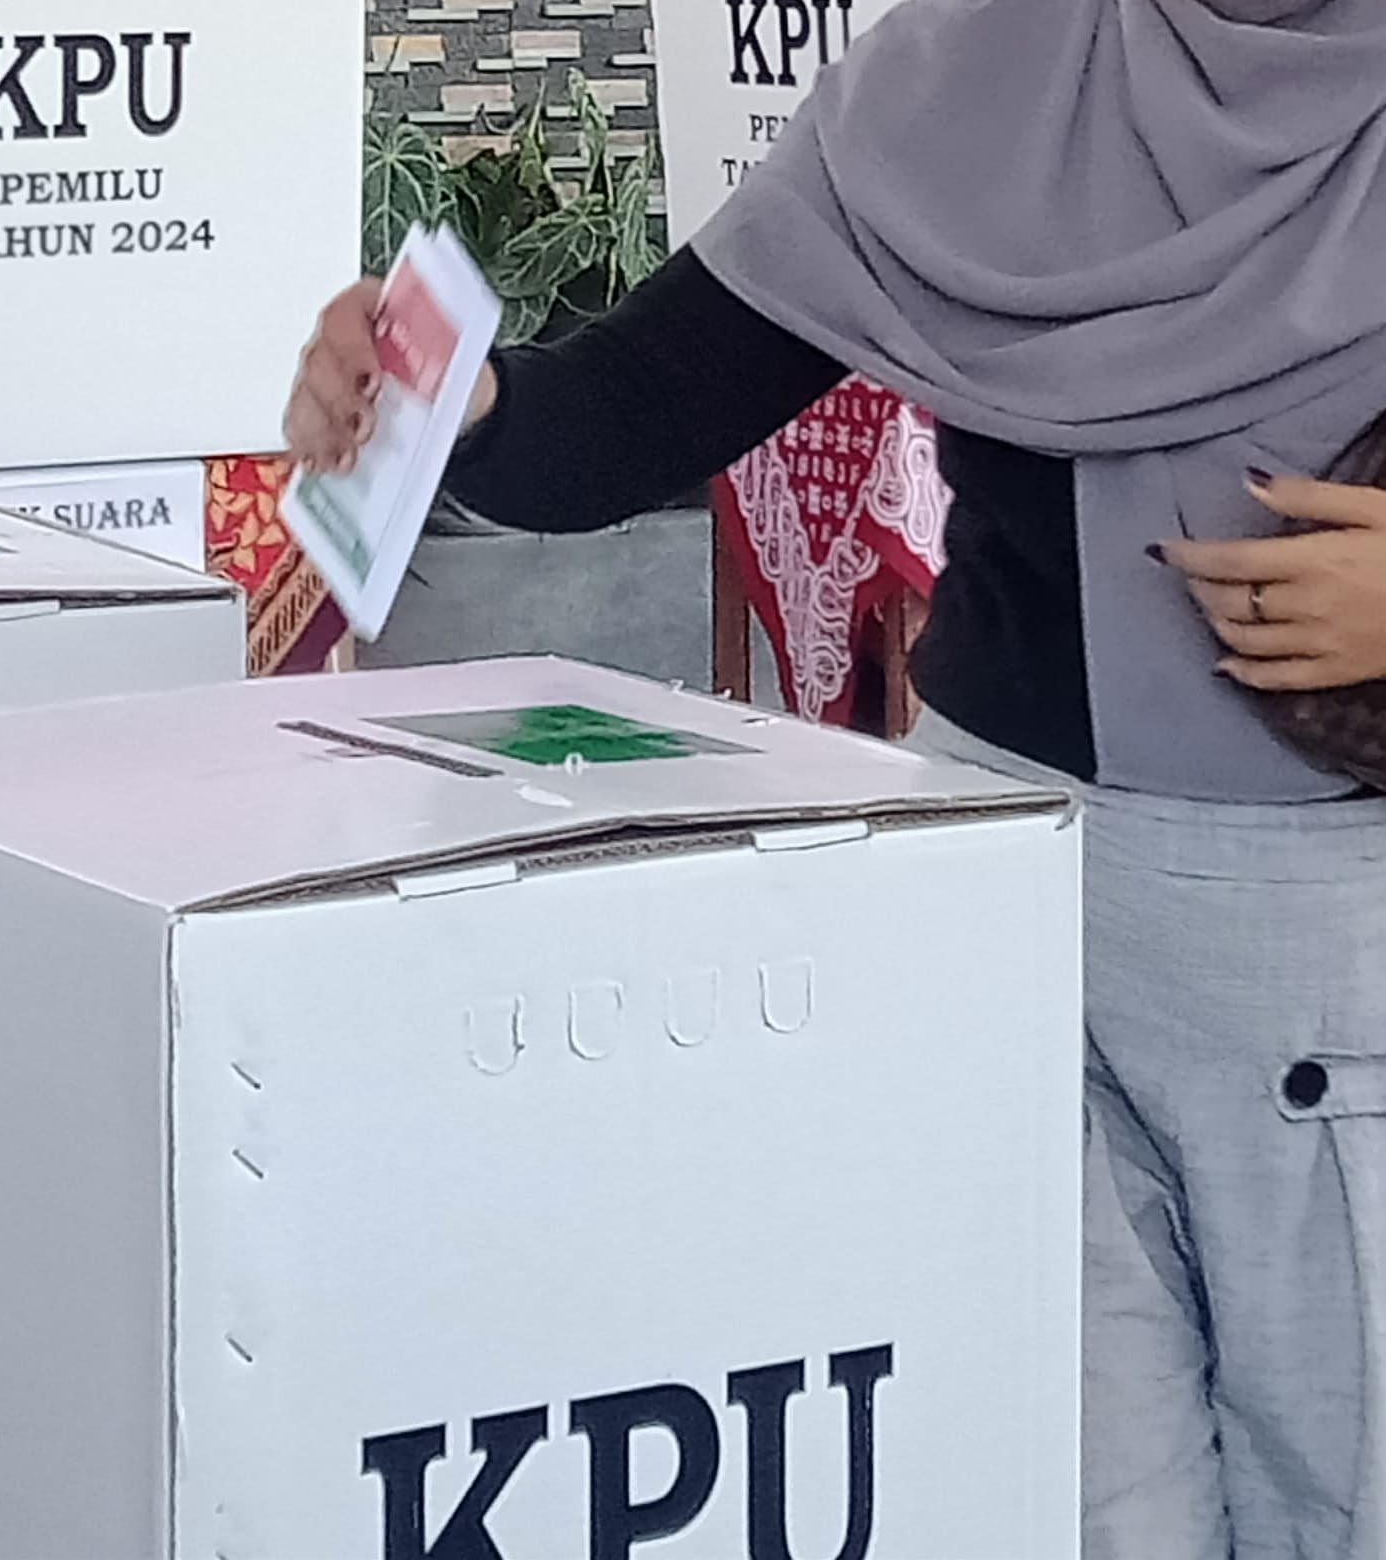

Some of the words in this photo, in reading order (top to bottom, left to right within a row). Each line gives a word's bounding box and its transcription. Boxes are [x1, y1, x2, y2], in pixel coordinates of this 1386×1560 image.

[110, 219, 216, 254] 2024
[53, 496, 172, 531] SUARA
[360, 1342, 894, 1560] KPU
